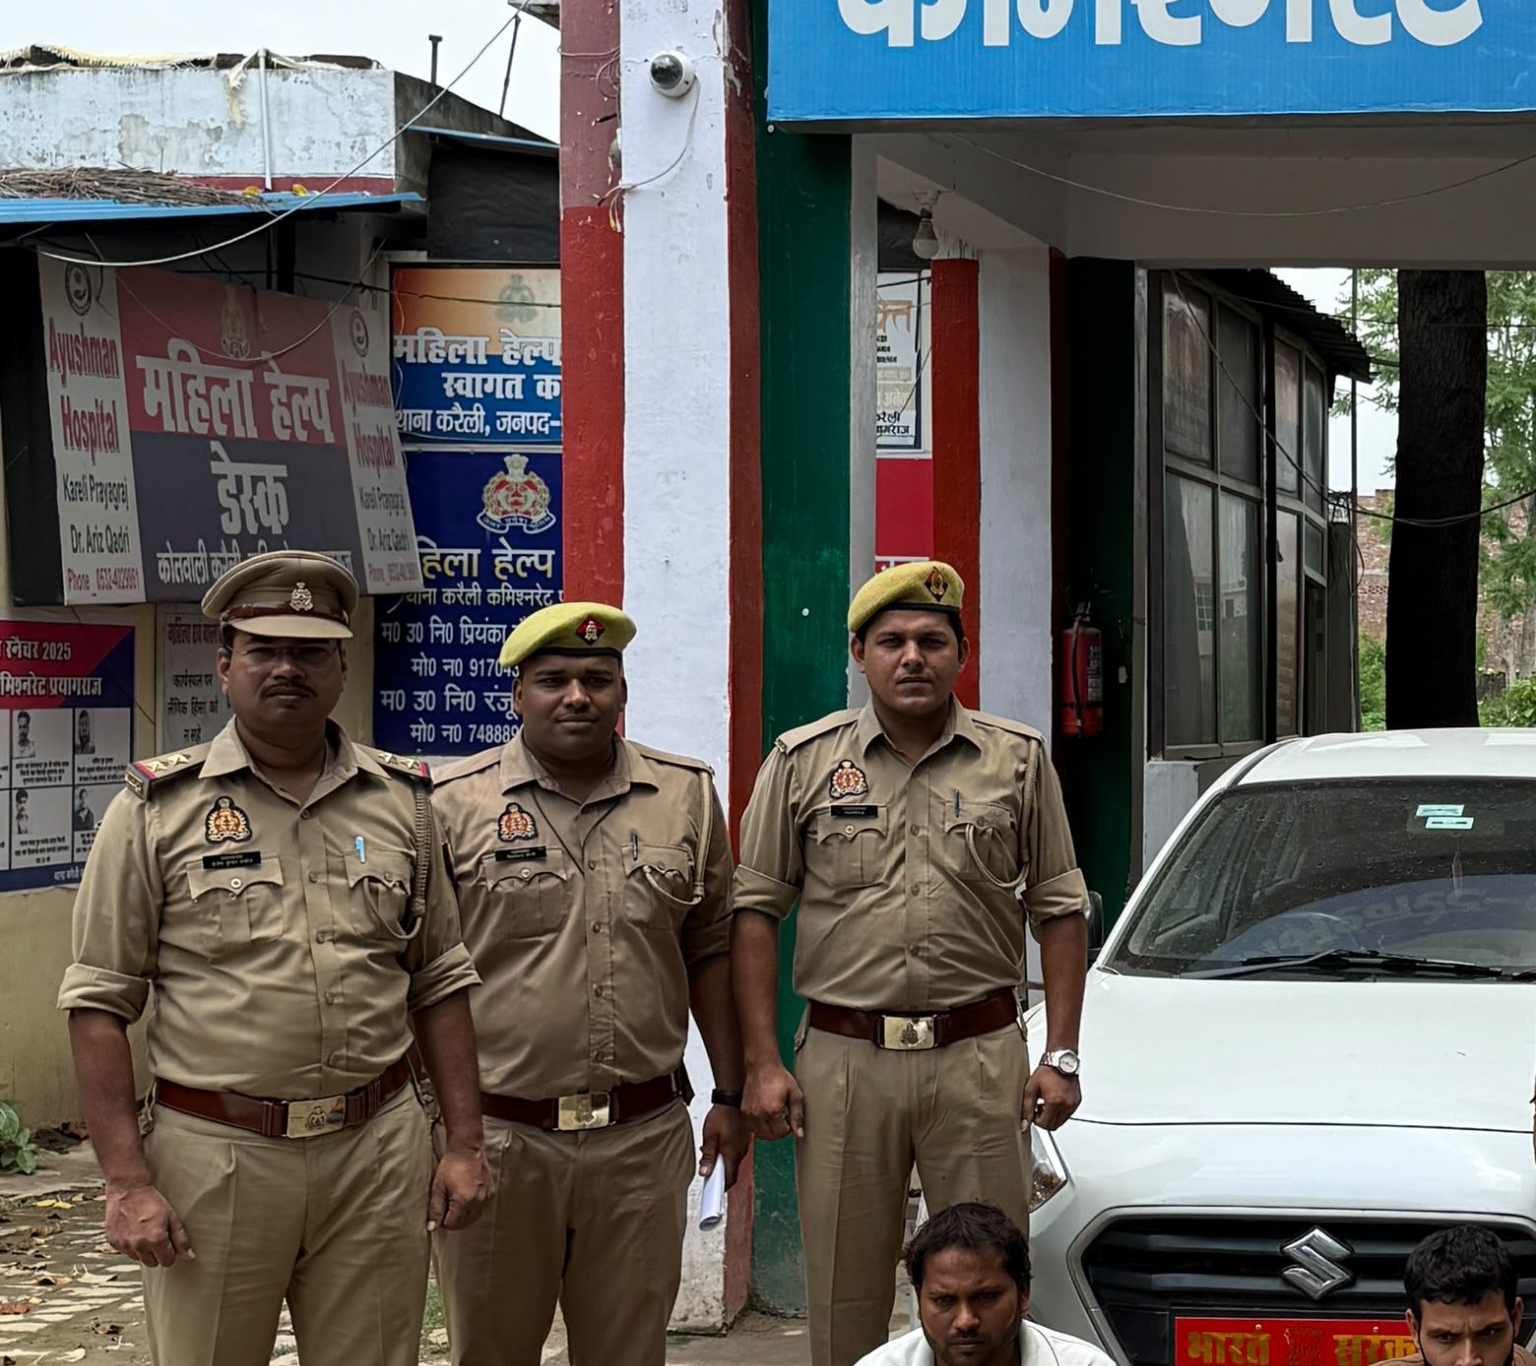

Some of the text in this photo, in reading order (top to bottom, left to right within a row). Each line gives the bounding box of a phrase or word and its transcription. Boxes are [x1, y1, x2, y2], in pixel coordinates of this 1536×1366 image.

[49, 317, 120, 388] Ayushman
[393, 327, 490, 365] महिला
[135, 338, 336, 443] महिला हेल्प
[441, 372, 526, 399] स्वागत
[61, 395, 119, 465] Hospital
[63, 473, 129, 511] Kareli Prayagraj
[210, 440, 290, 535] डेस्क
[70, 524, 85, 553] Dr.
[417, 535, 482, 579] हिला
[492, 537, 555, 580] हेल्प
[156, 538, 209, 584] कोतवाली
[442, 581, 482, 606] करैली
[487, 582, 553, 607] कमिश्नरेट
[42, 642, 72, 661] 2025
[0, 671, 102, 696] मिश्नरेट प्रयागराज
[1188, 1331, 1419, 1366] भारत सरक
